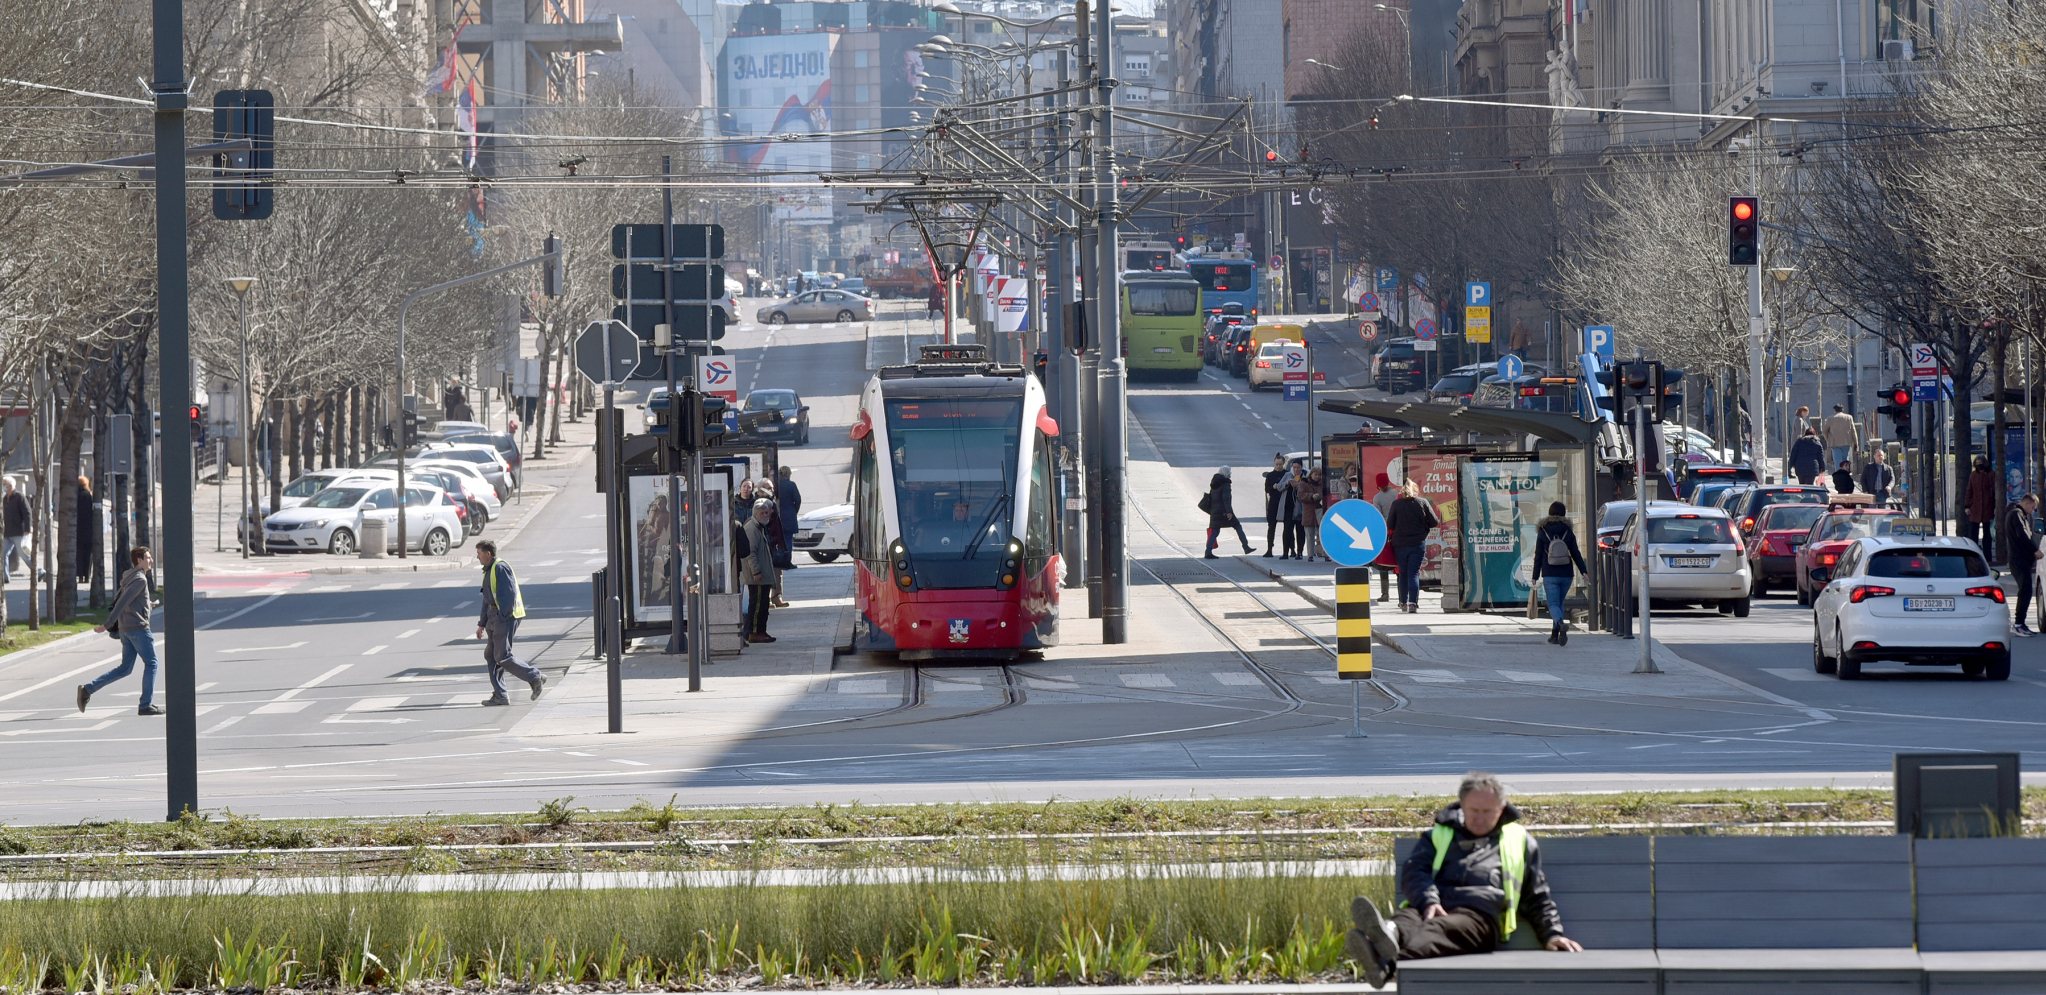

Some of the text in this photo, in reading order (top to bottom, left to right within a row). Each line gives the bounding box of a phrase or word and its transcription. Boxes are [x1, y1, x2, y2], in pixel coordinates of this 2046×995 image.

[733, 51, 825, 80] ЗАЈЕДНО!
[1215, 266, 1228, 275] EK02
[1381, 268, 1393, 285] P
[1471, 285, 1485, 304] P
[1591, 329, 1607, 352] P
[1331, 447, 1351, 455] Tako
[1426, 472, 1441, 482] za
[1422, 481, 1454, 494] dobro
[1480, 478, 1541, 491] SANYTOL
[1468, 535, 1520, 544] DEZINFEKCIJA
[1674, 557, 1682, 566] BG
[1909, 599, 1920, 608] BG
